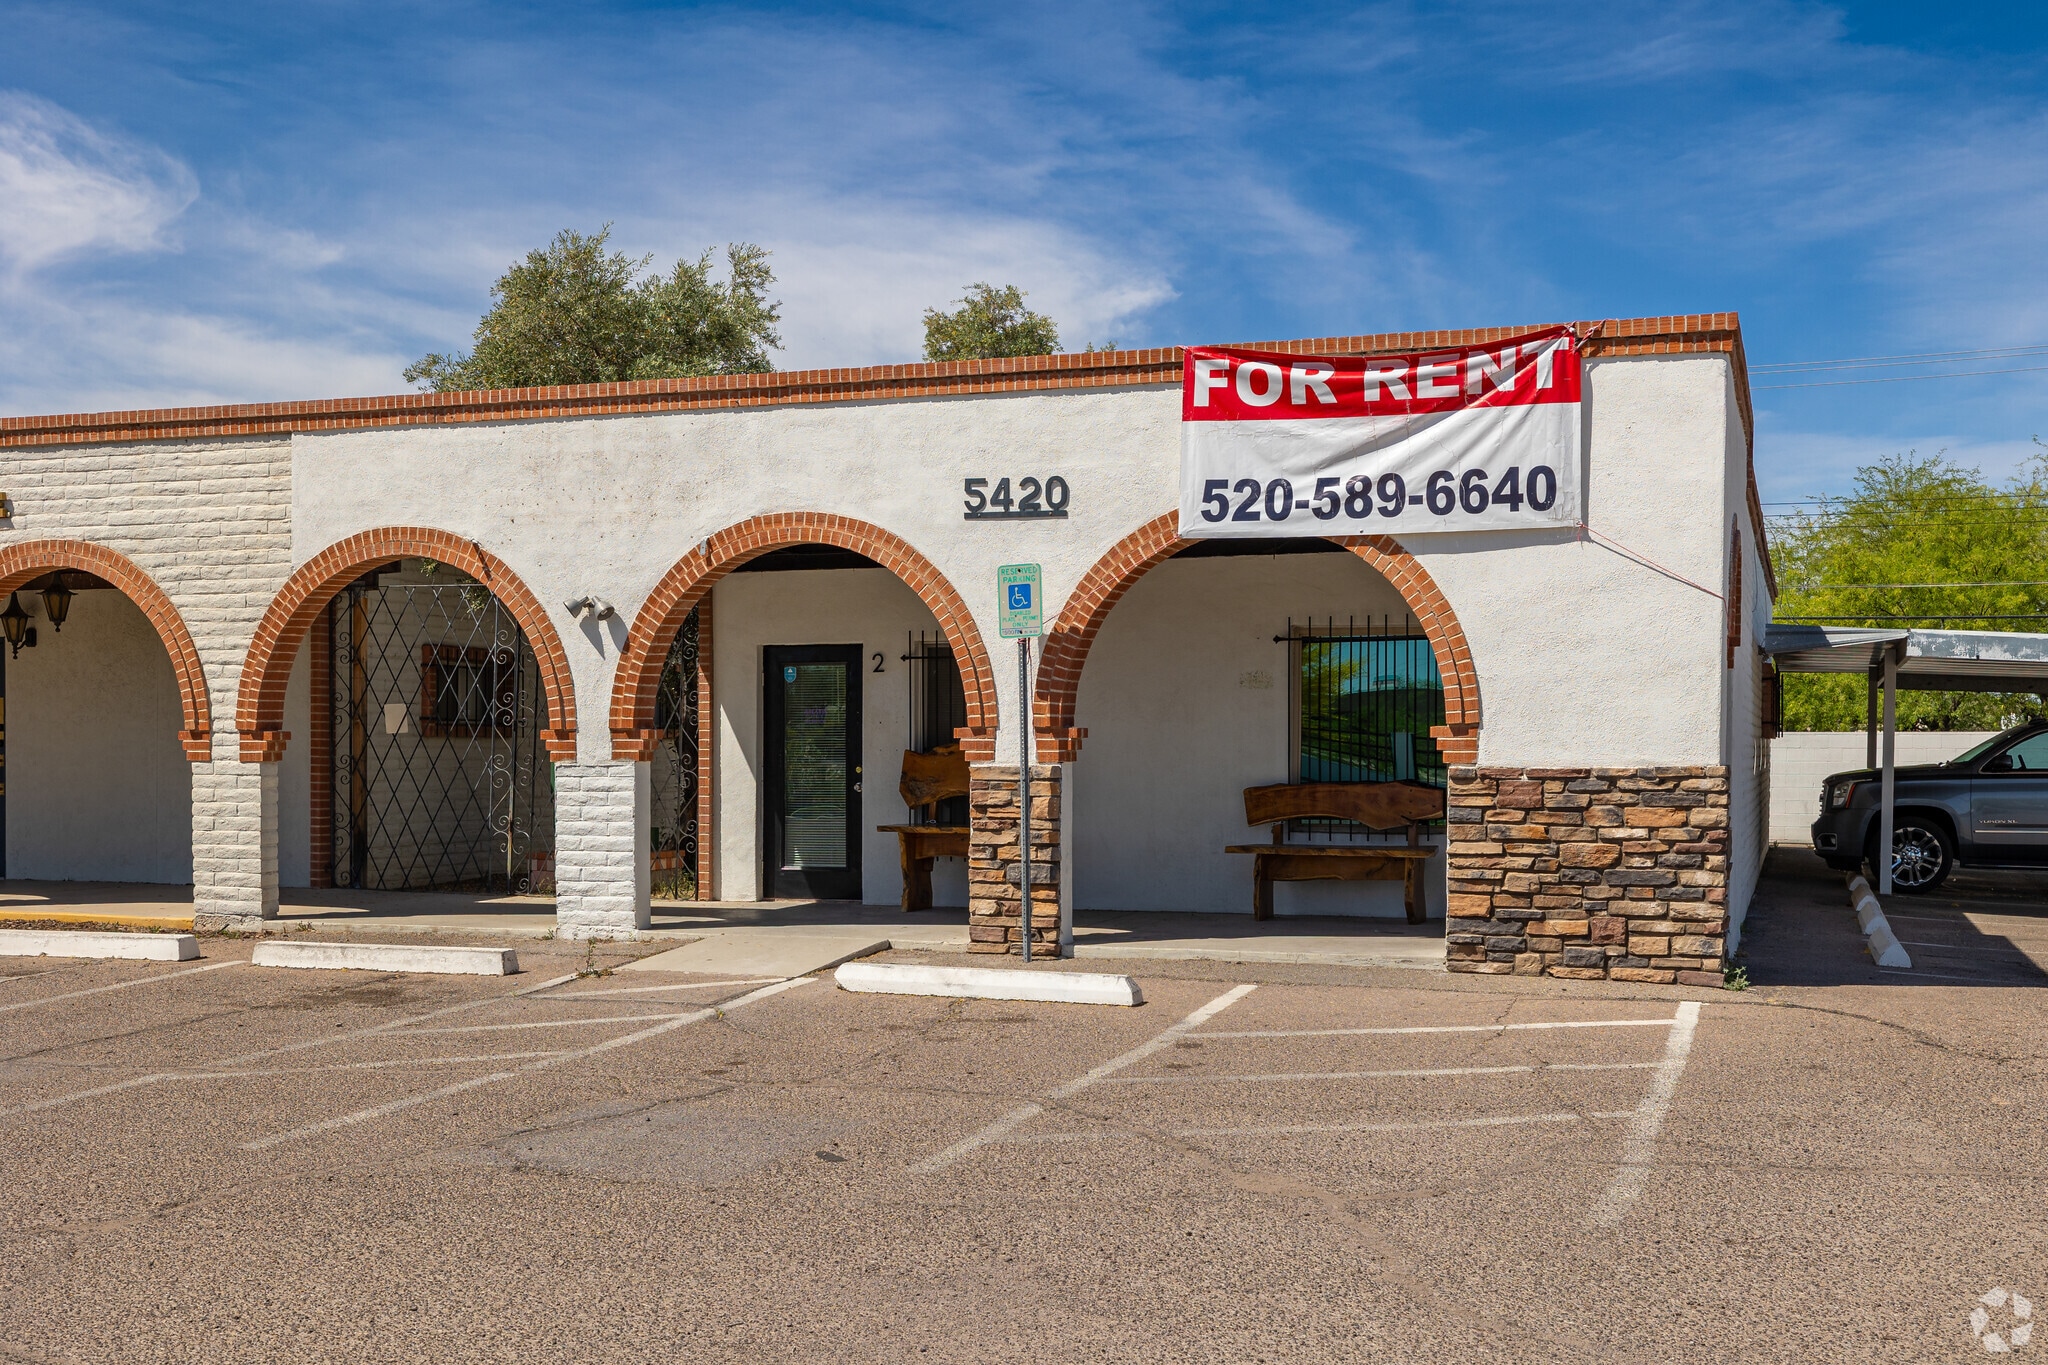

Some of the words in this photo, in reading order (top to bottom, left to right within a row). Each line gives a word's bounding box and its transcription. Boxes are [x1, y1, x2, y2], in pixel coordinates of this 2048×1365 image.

[1194, 359, 1337, 407] FOR
[1364, 337, 1570, 401] RENT
[963, 475, 1070, 513] 5420
[1200, 465, 1557, 523] 520-589-6640
[1001, 567, 1037, 575] RESERVED
[1003, 575, 1036, 583] PARKING
[872, 653, 885, 673] 2
